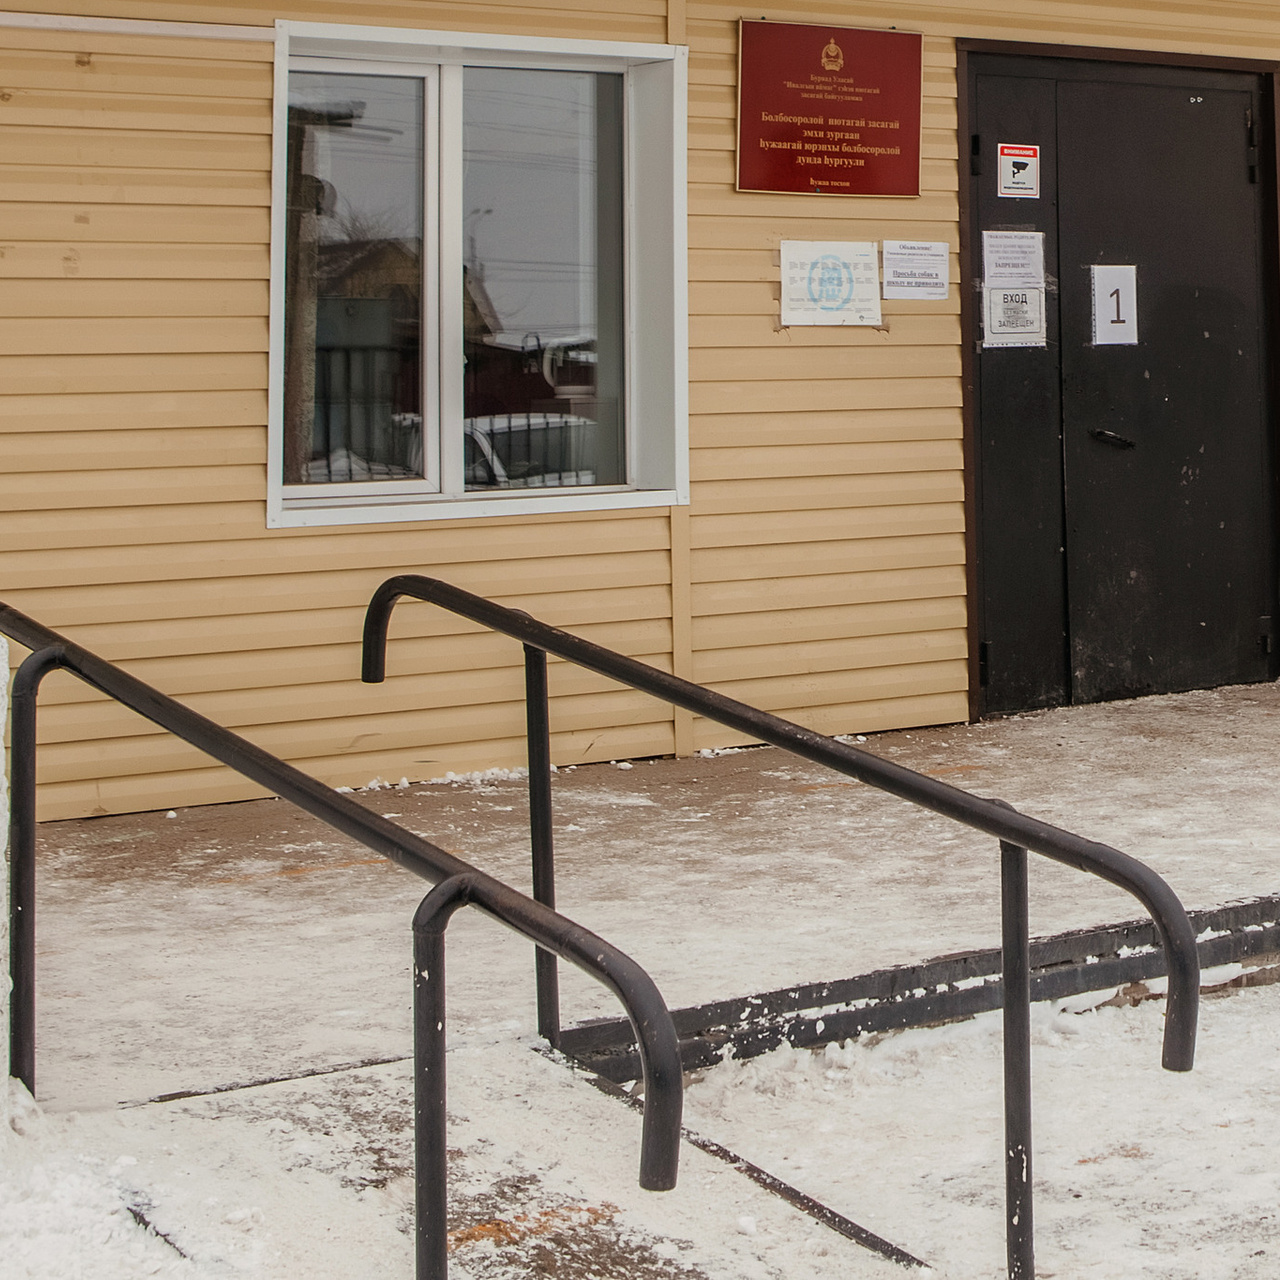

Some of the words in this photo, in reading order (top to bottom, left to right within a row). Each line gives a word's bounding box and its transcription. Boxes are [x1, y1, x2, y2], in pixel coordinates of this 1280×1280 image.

[762, 112, 823, 126] Болбосоролой
[829, 117, 866, 127] нютагай
[868, 120, 899, 129] засагай
[803, 129, 824, 138] эмхи
[826, 131, 860, 141] зургаан
[805, 144, 839, 153] юрэнхы
[842, 143, 900, 156] болбосоролой
[796, 156, 822, 165] дунда
[1003, 294, 1027, 305] ВХОД
[1110, 288, 1126, 325] 1
[998, 320, 1034, 328] ЗАПРЕЩЕН
